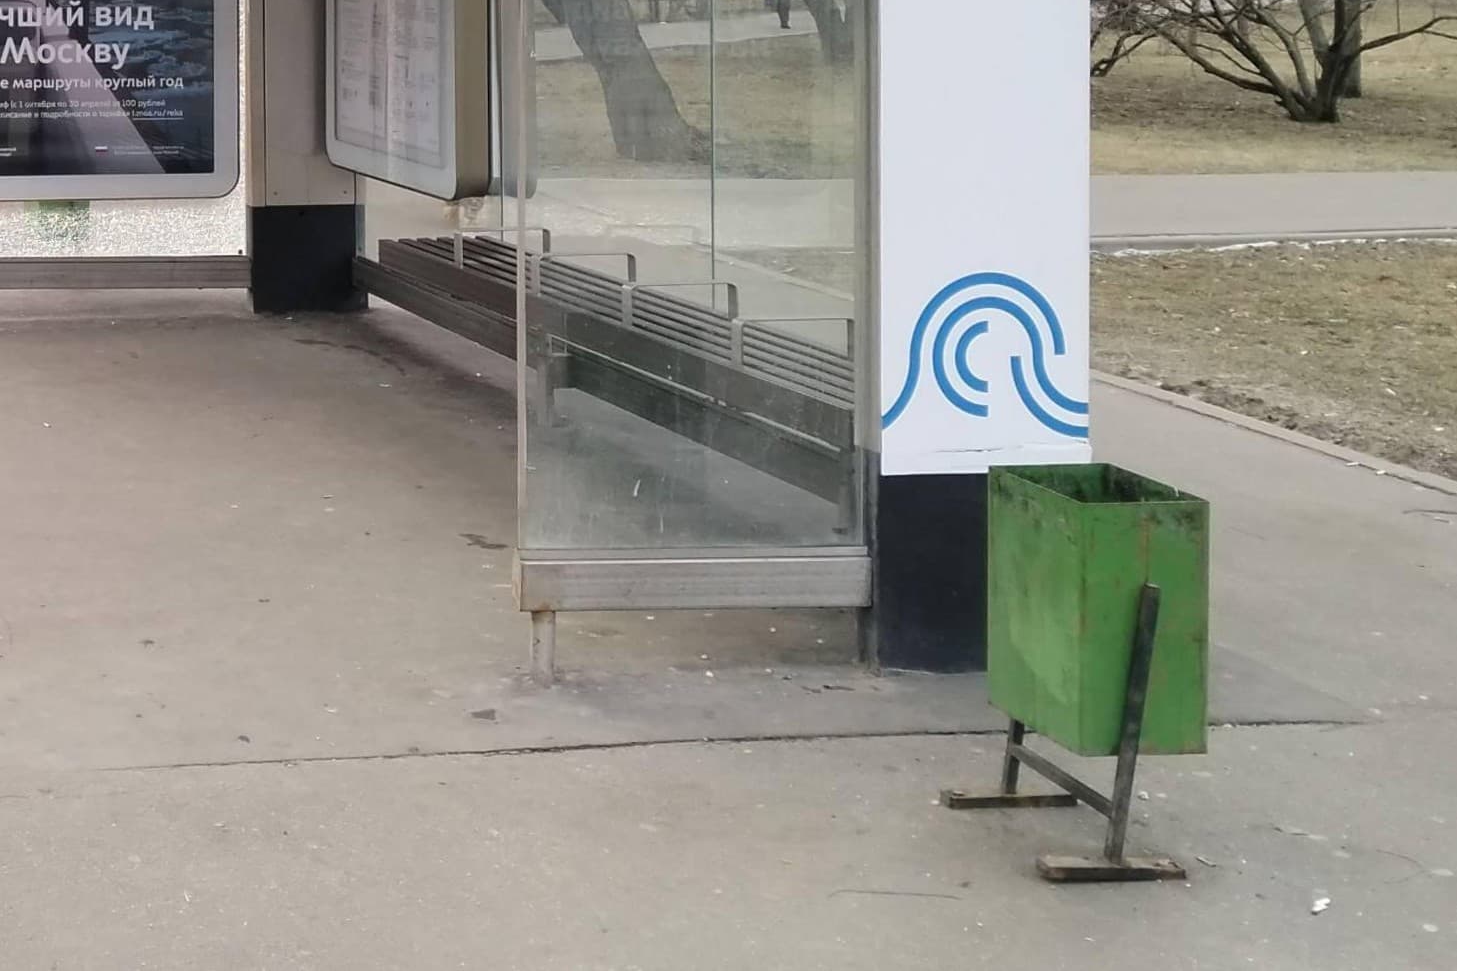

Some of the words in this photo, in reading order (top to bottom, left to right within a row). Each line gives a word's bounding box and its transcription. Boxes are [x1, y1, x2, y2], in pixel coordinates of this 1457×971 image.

[94, 1, 155, 31] вид
[0, 37, 130, 70] Москву
[12, 77, 91, 92] маршруты
[95, 75, 156, 91] круглый
[160, 77, 184, 89] год
[122, 99, 137, 107] 100
